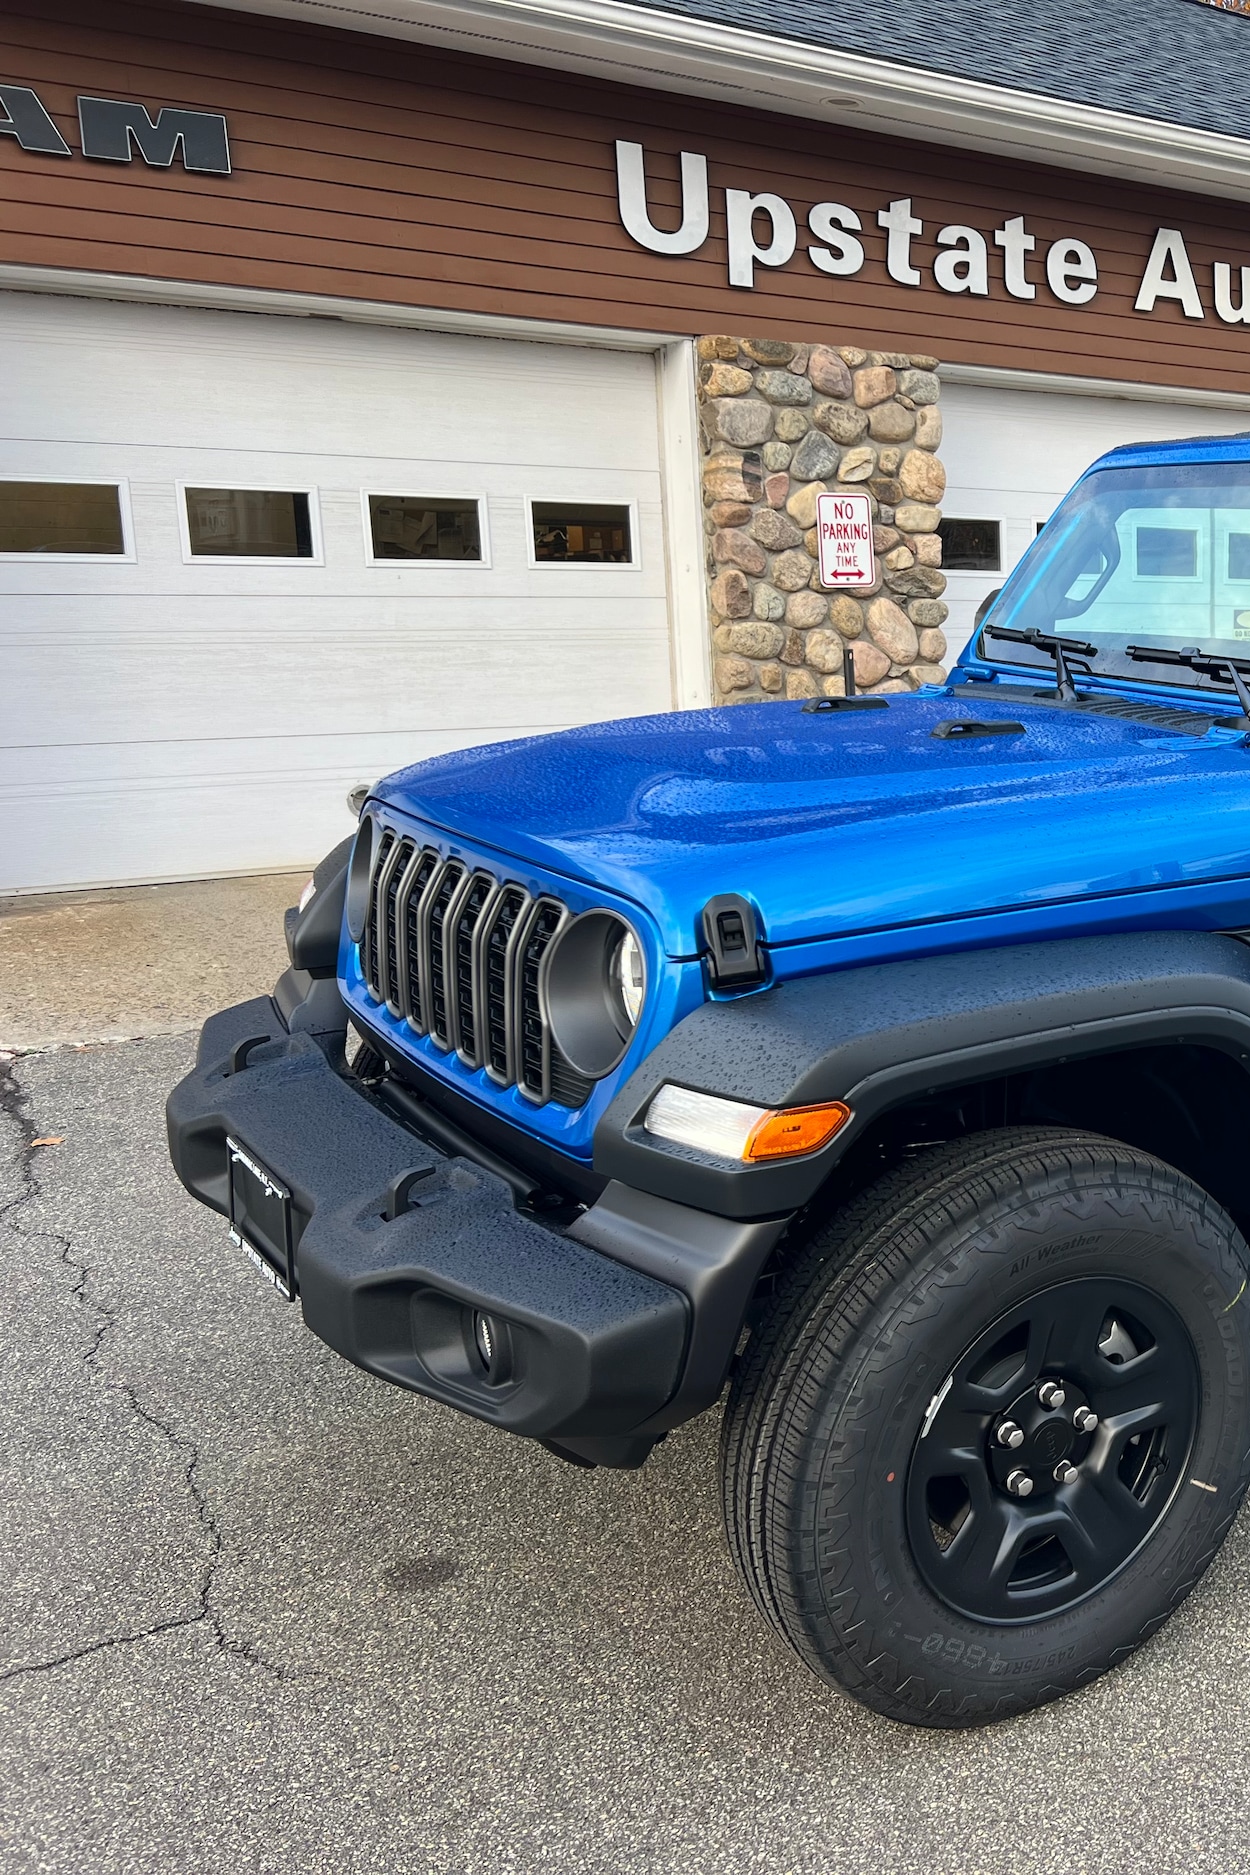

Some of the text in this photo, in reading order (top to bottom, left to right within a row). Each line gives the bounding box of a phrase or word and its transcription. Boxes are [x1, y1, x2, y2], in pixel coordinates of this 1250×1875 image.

[614, 138, 1099, 306] Upstate
[833, 502, 854, 520] NO
[822, 523, 868, 540] PARKING
[836, 542, 856, 554] ANY
[835, 555, 859, 567] TIME
[1009, 1233, 1104, 1278] All-Weather
